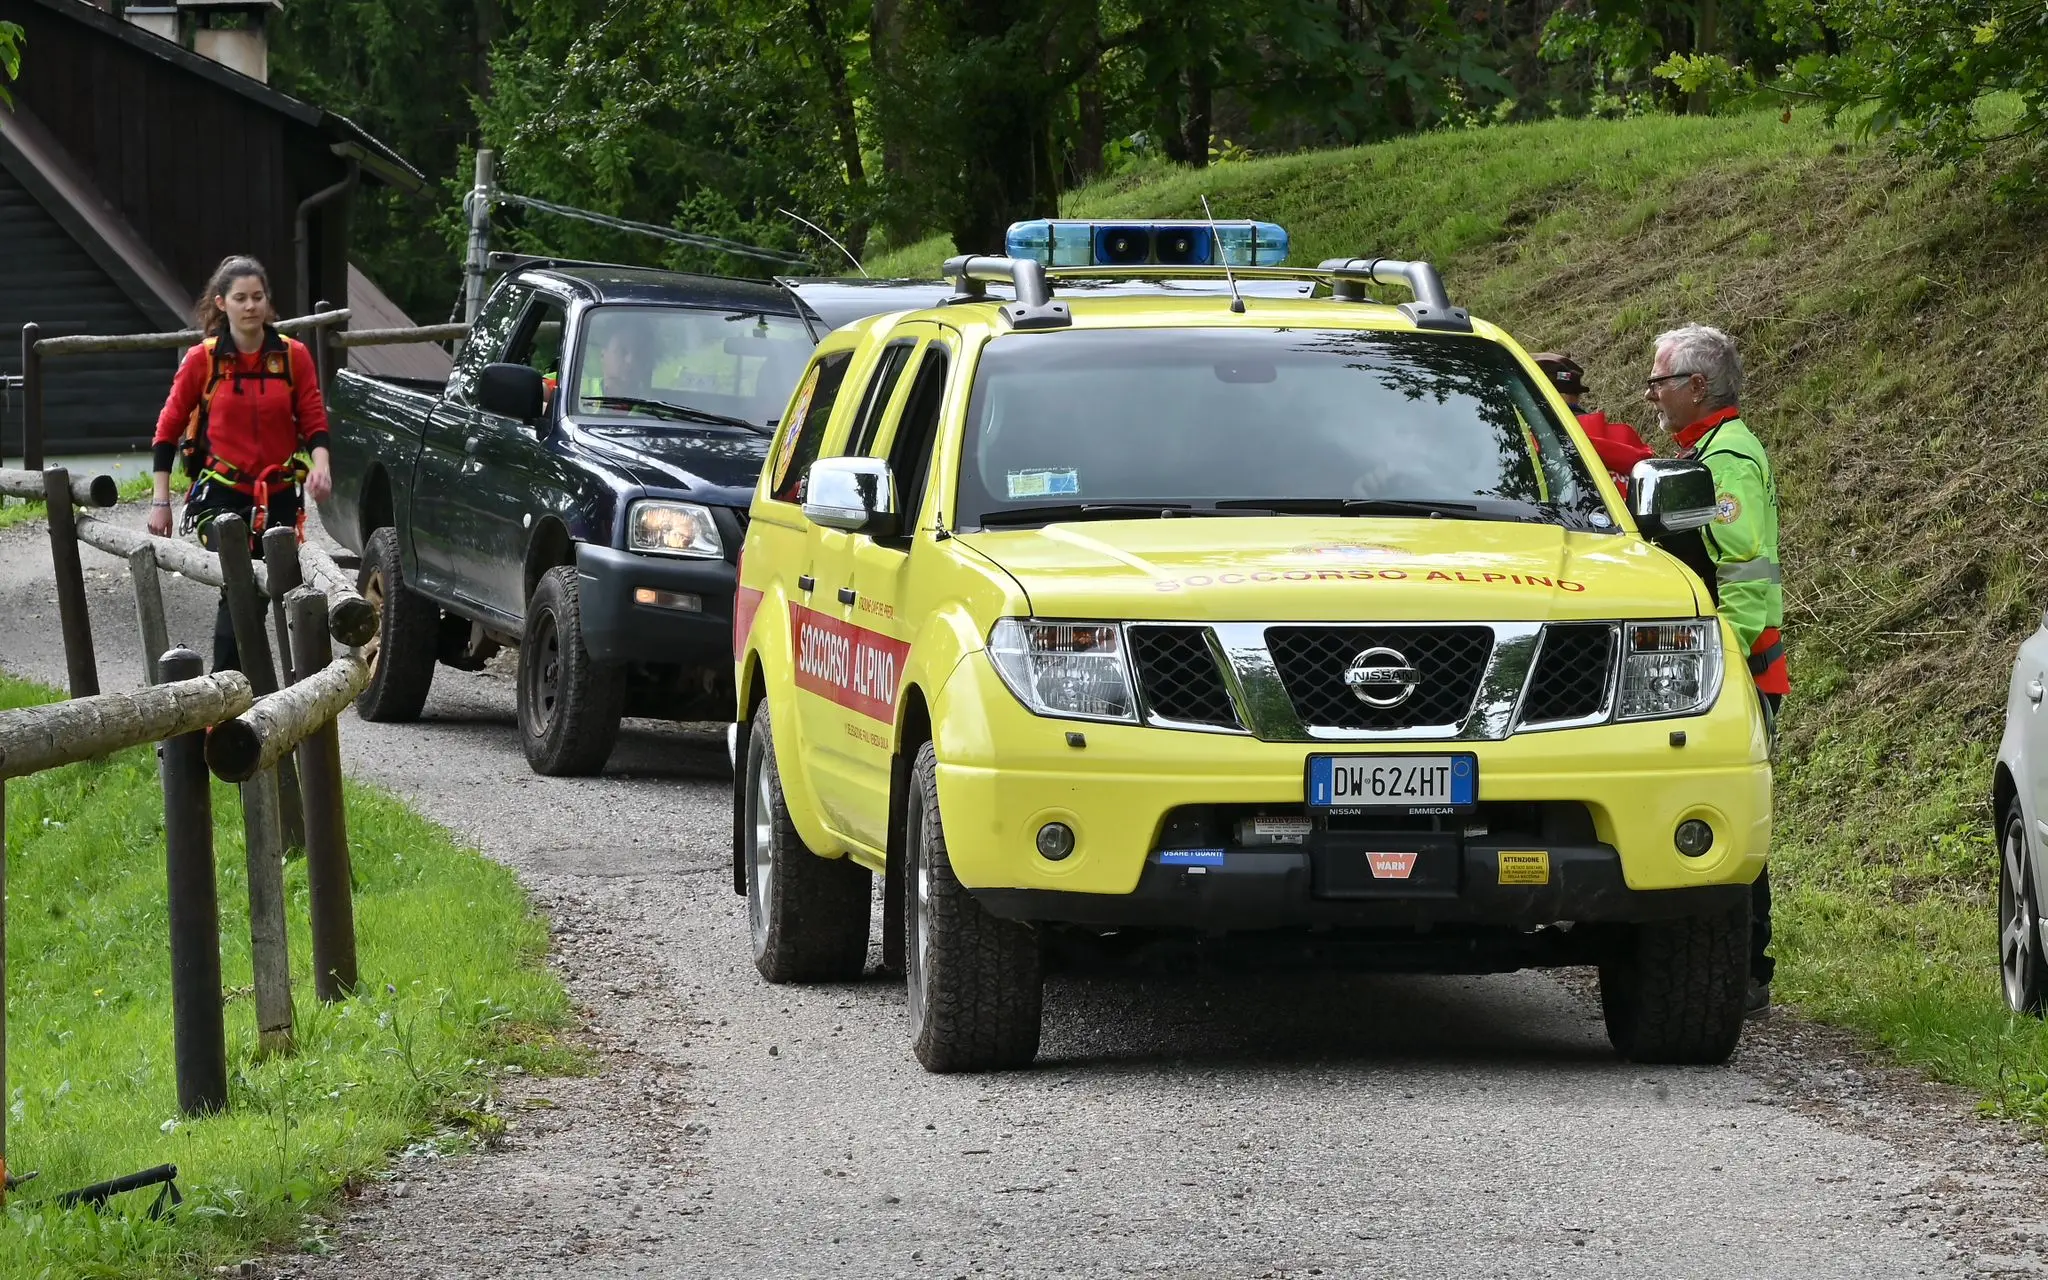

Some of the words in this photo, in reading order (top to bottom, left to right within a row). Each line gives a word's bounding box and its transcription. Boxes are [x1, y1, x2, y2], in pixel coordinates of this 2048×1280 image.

[1155, 569, 1408, 592] SOCCORSO
[1425, 570, 1586, 592] ALPINO
[800, 622, 849, 688] SOCCORSO
[854, 643, 894, 705] ALPINO
[1353, 671, 1413, 682] NISSAN
[1409, 807, 1454, 815] EMMECAR
[1376, 861, 1405, 871] WARN
